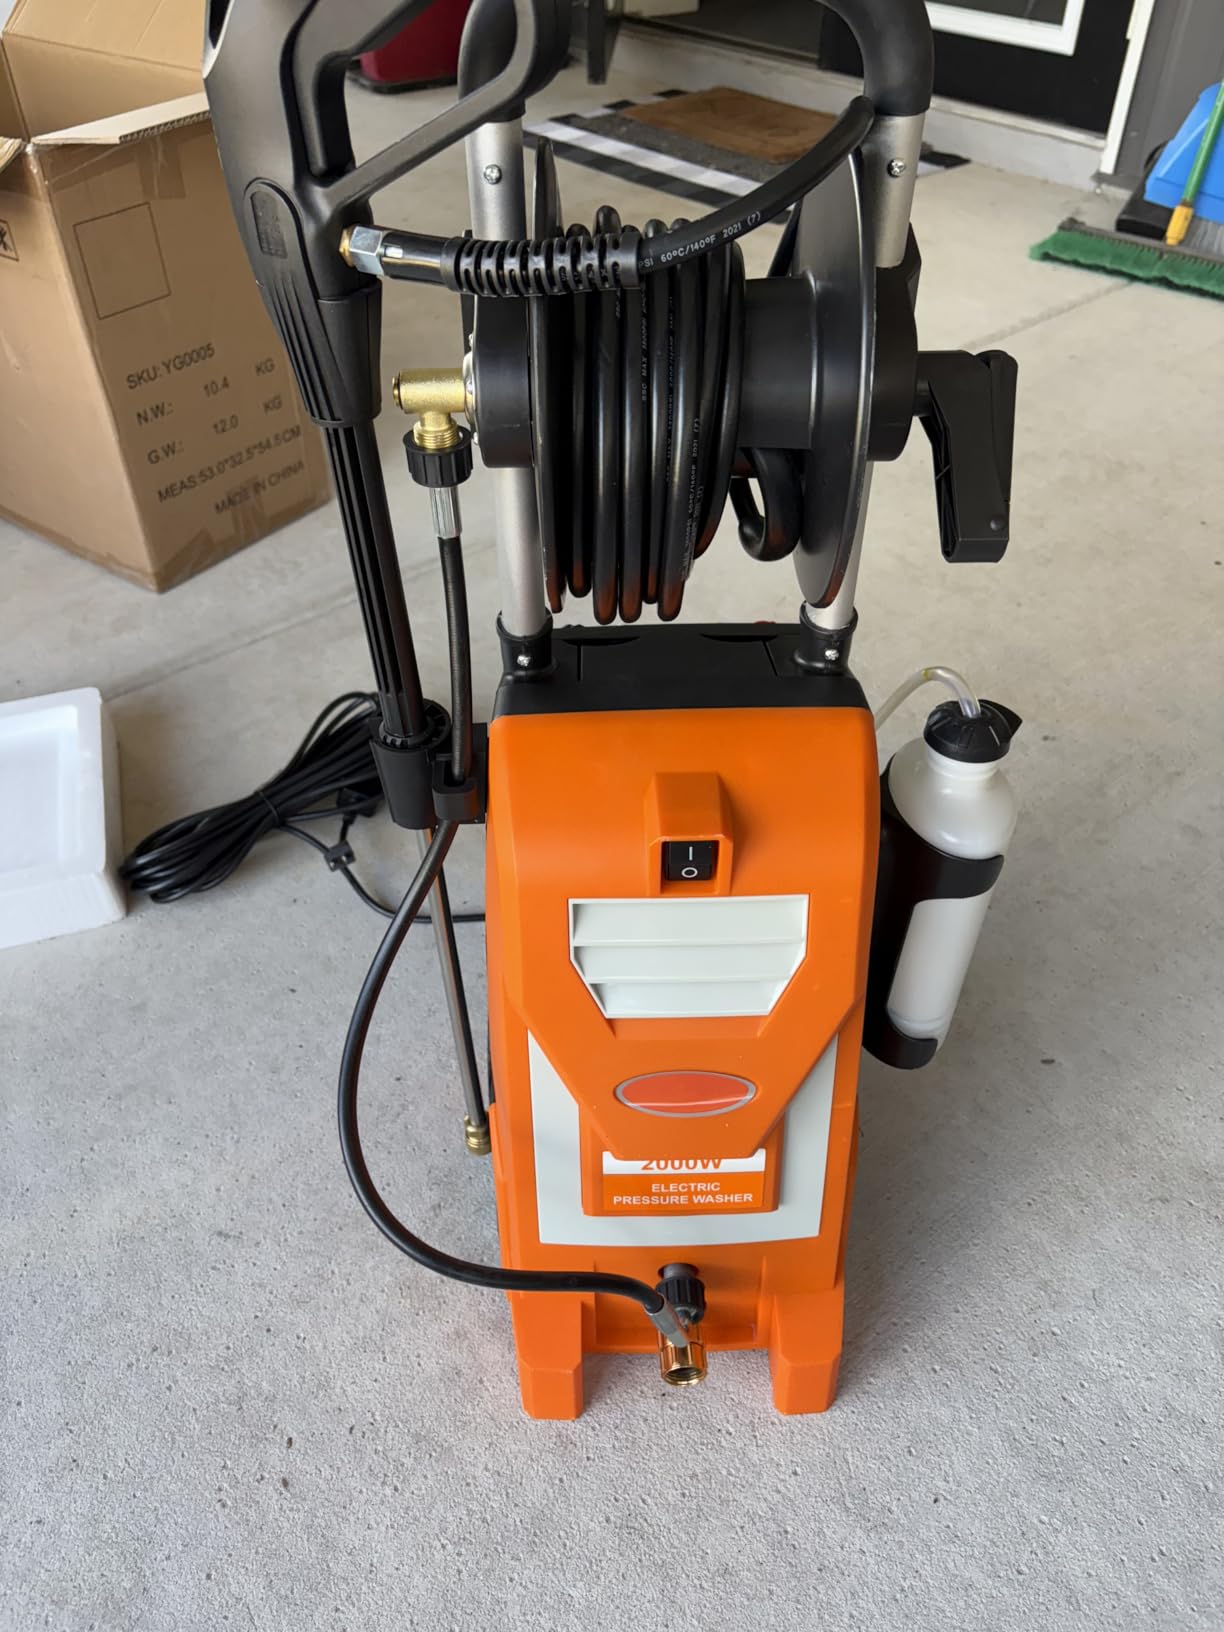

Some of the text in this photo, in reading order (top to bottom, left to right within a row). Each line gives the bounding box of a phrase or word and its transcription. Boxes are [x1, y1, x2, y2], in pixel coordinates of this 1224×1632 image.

[722, 223, 742, 238] 2021
[746, 211, 761, 226] (7)
[136, 358, 275, 425] N.W.: 10.4 KG
[213, 415, 239, 434] 12.0
[263, 395, 283, 414] KG
[214, 461, 304, 513] MADE IN CHINA
[641, 1158, 723, 1171] 2000W
[613, 1193, 753, 1205] PRESSURE WASHER
[652, 1182, 721, 1193] ELECTRIC
